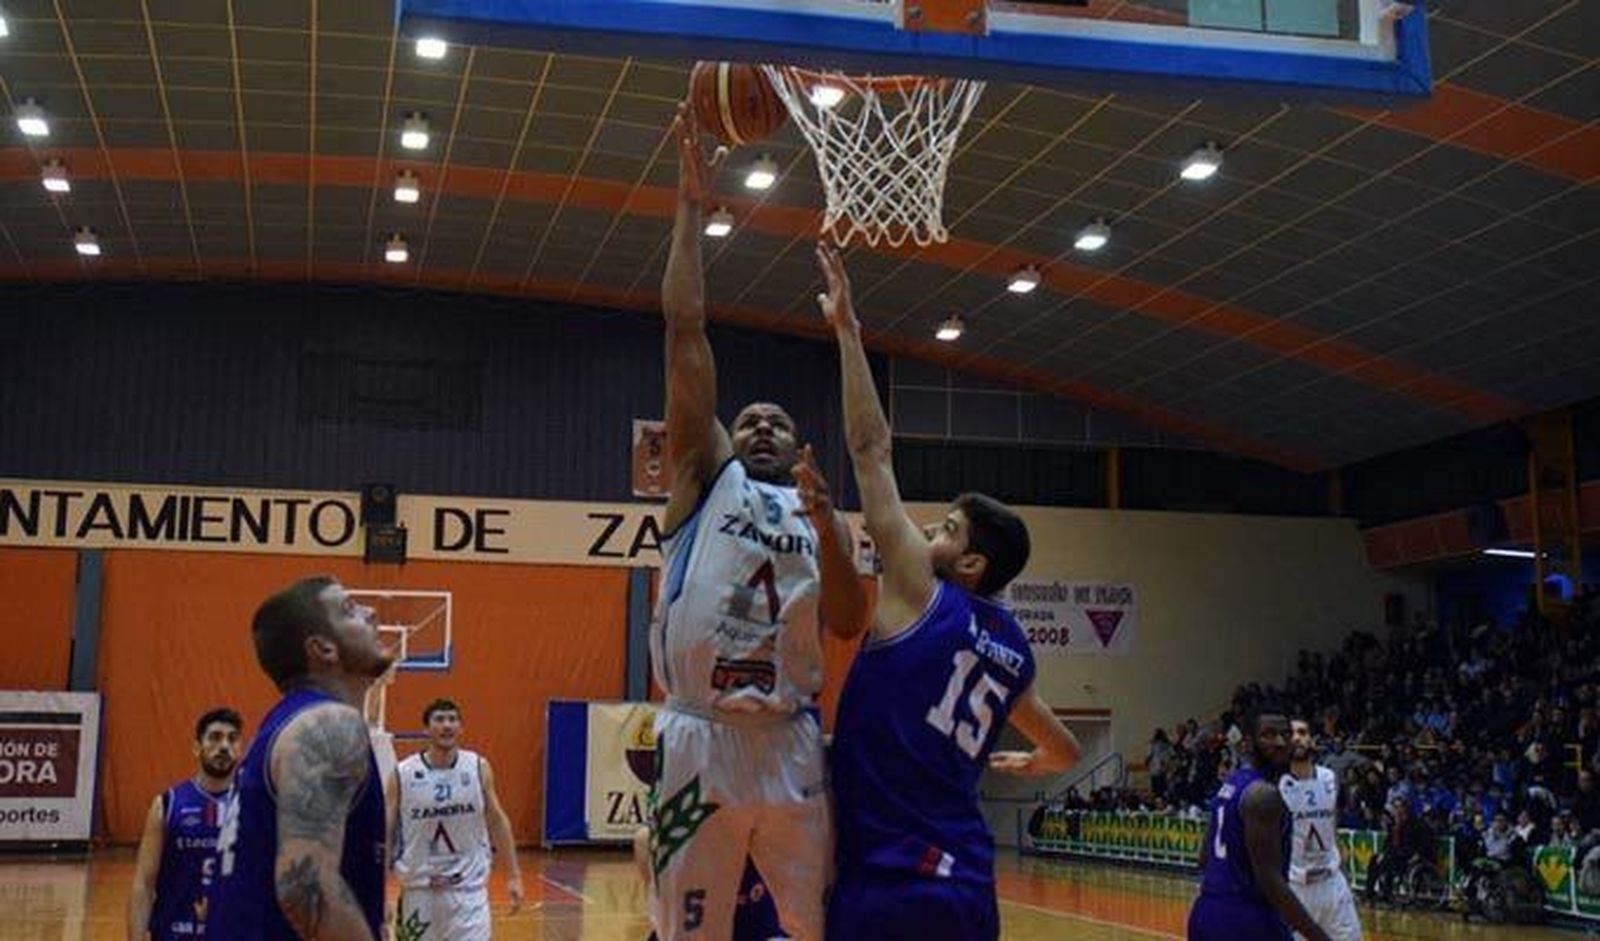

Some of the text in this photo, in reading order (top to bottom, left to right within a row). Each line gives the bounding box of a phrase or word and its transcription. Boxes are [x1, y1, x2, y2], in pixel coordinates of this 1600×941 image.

[0, 488, 355, 547] NTAMIENTO
[434, 507, 510, 553] DE
[1027, 627, 1070, 646] 2008
[926, 649, 1010, 760] 15
[34, 741, 58, 758] DE
[0, 760, 58, 784] ORA
[434, 784, 452, 802] 21
[1305, 790, 1317, 806] 2
[683, 889, 706, 932] 5
